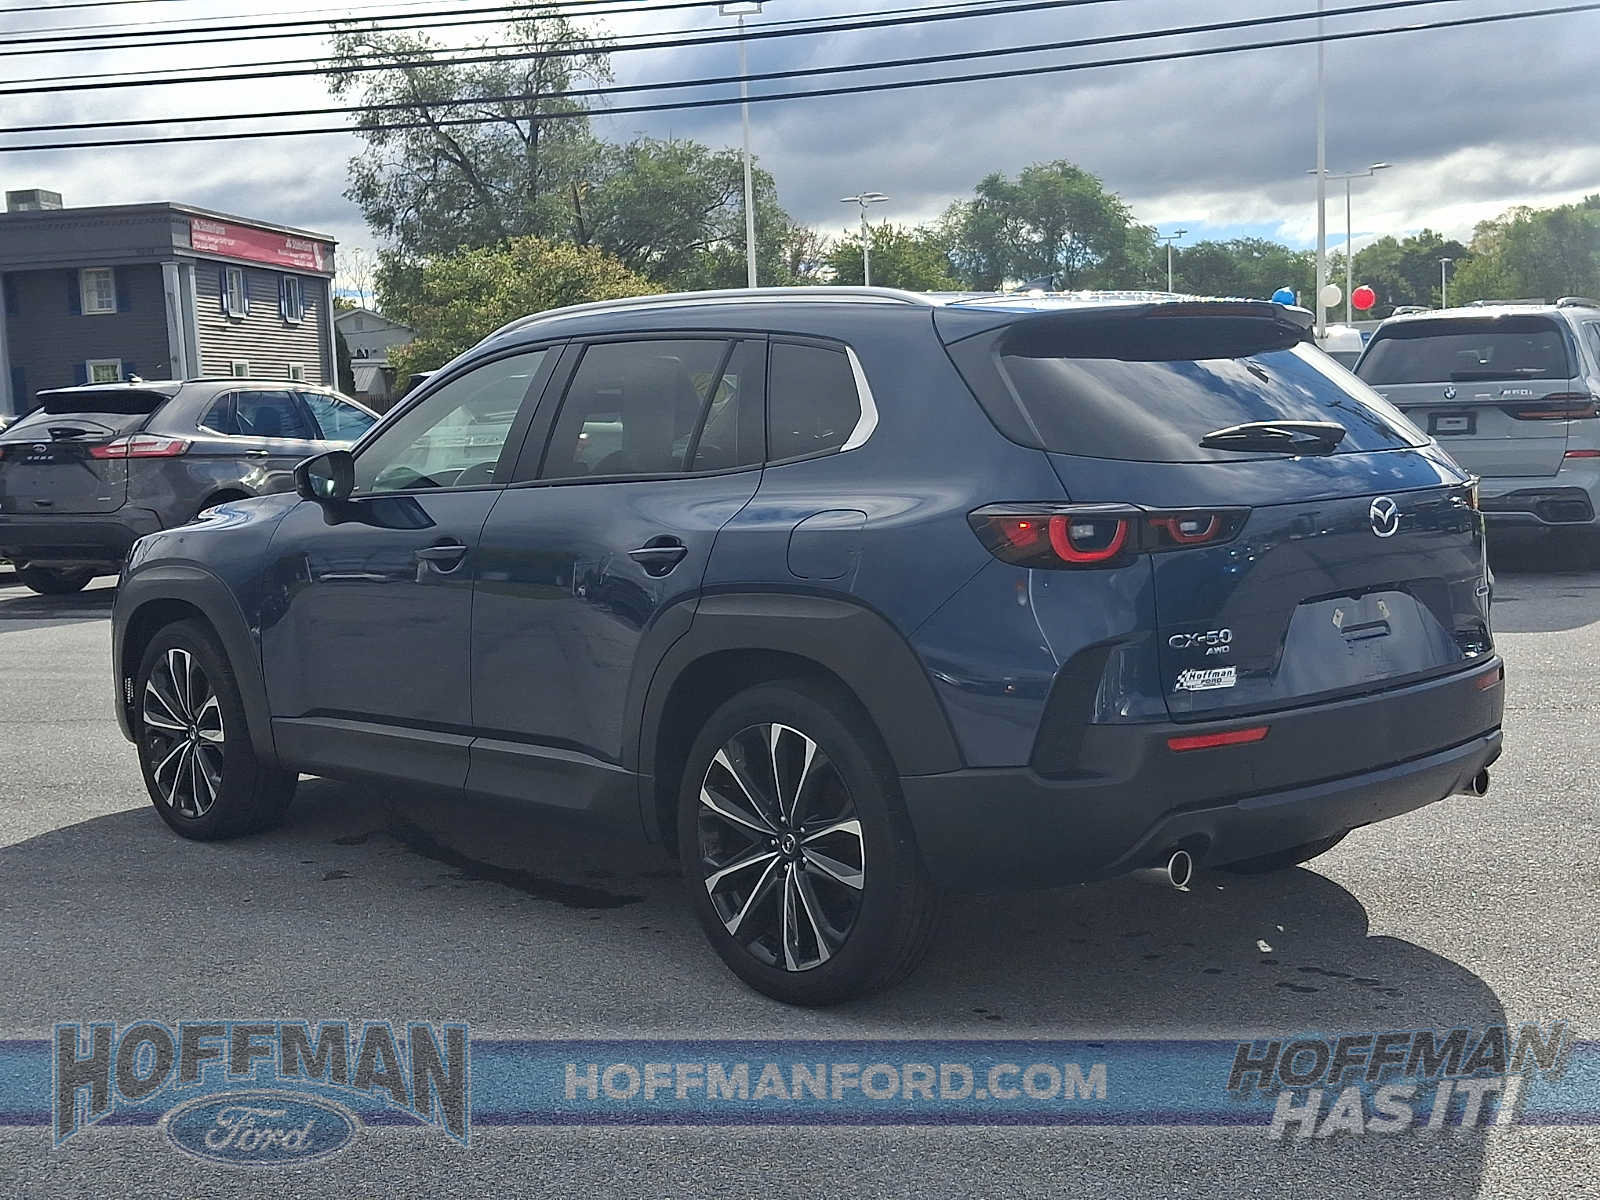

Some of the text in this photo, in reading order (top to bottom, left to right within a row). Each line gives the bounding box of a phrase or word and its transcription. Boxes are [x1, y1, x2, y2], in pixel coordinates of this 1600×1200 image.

[1169, 629, 1232, 648] CX-50
[1205, 645, 1230, 655] AWD
[1189, 671, 1232, 680] Hoffman
